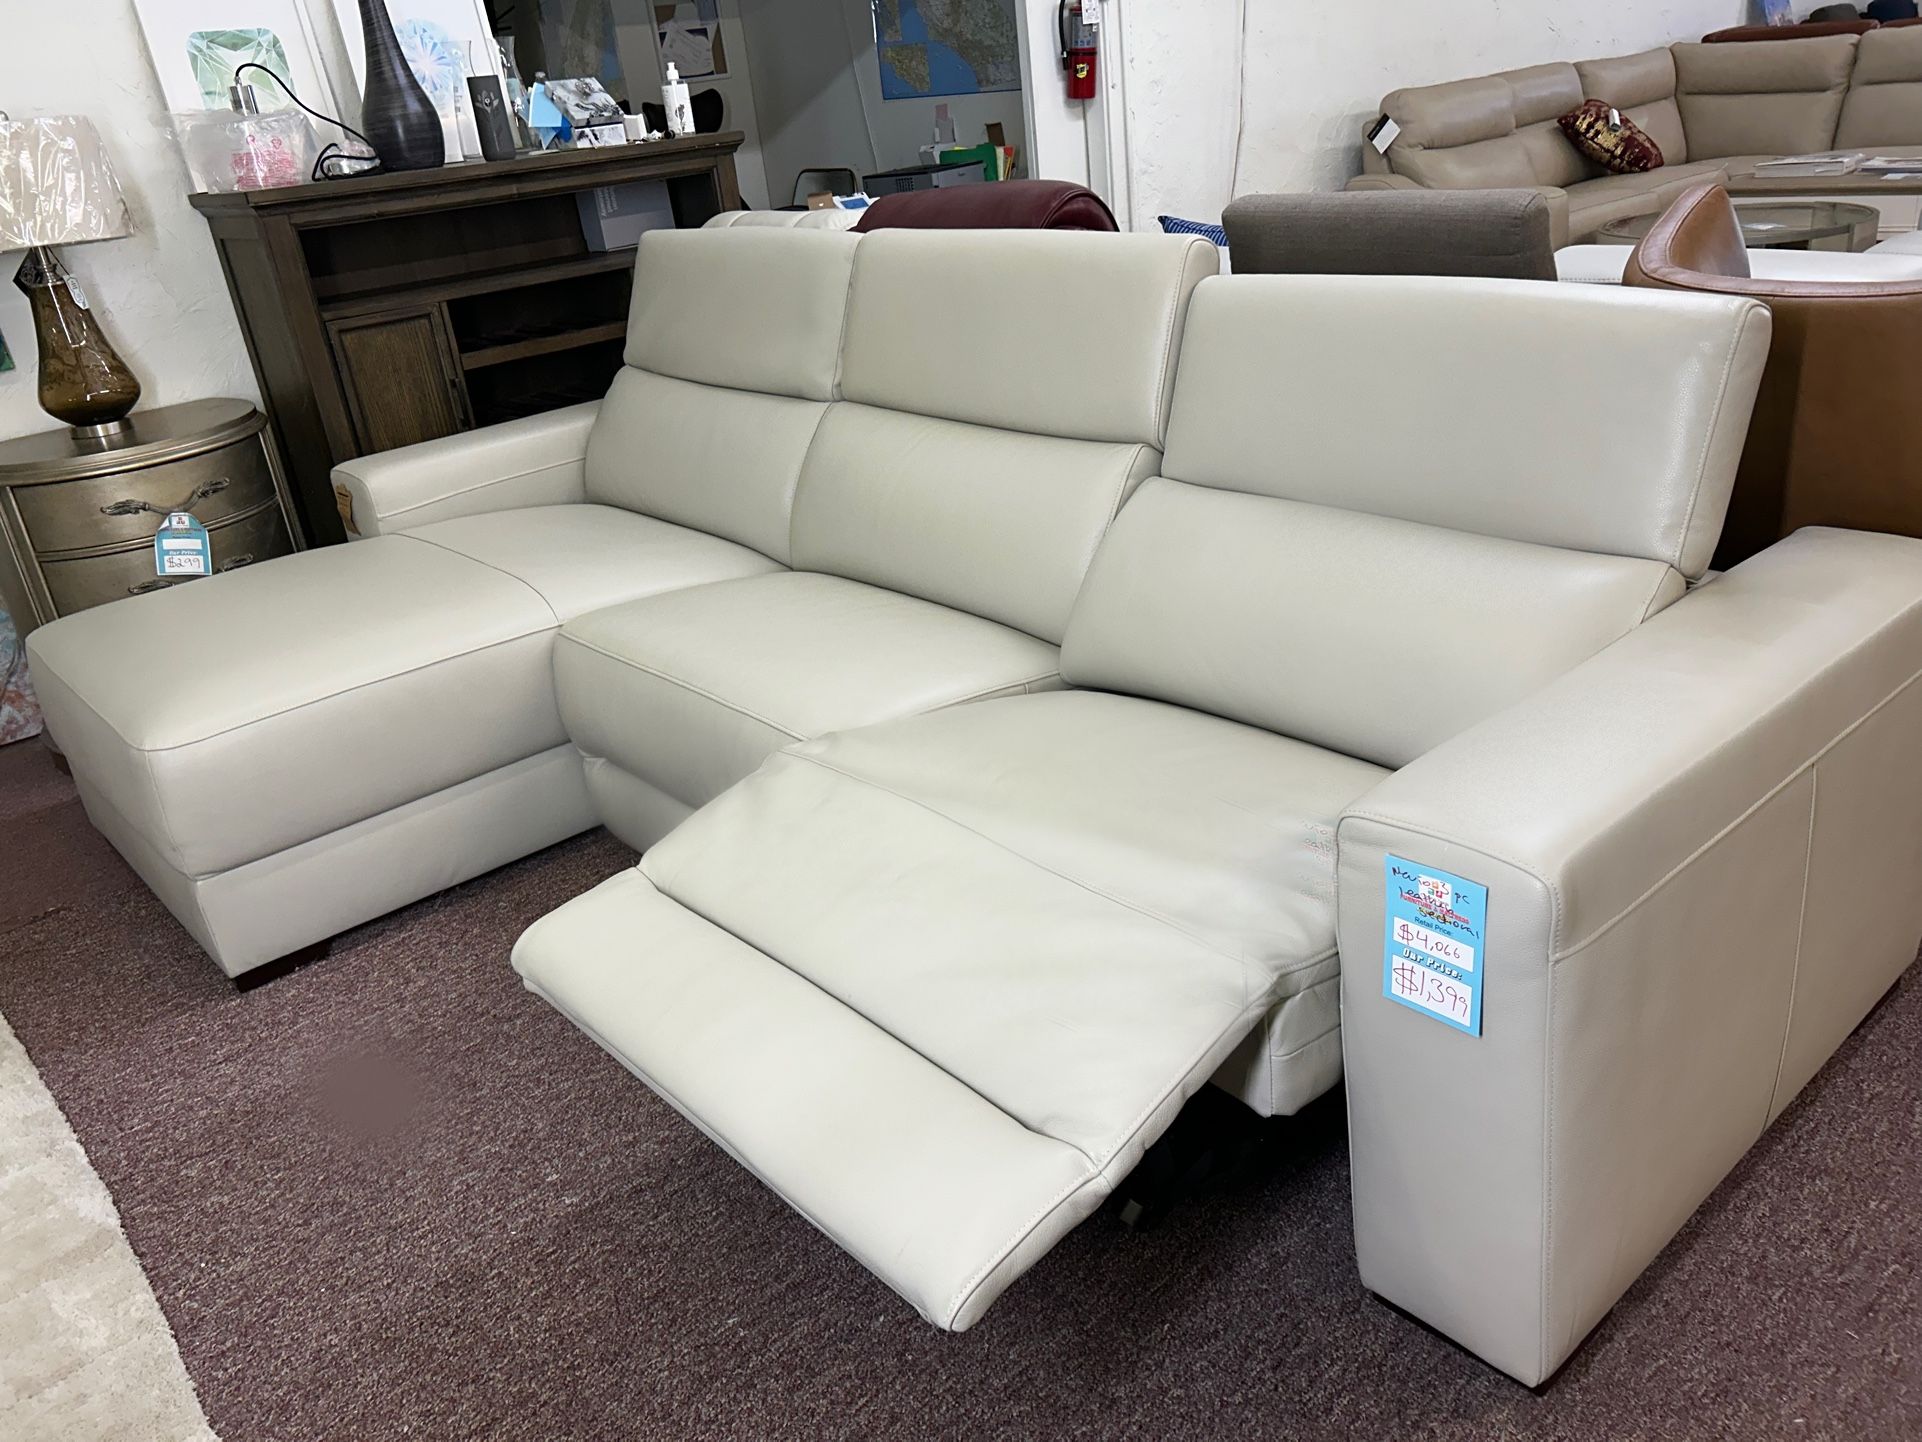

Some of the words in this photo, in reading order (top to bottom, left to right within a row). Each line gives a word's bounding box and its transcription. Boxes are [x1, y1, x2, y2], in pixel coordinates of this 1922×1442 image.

[166, 557, 201, 569] $299
[1414, 917, 1433, 929] Retail
[1397, 923, 1460, 959] $4,066
[1402, 947, 1424, 964] Our
[1426, 957, 1463, 981] Price:
[1392, 962, 1468, 1017] $1,399
